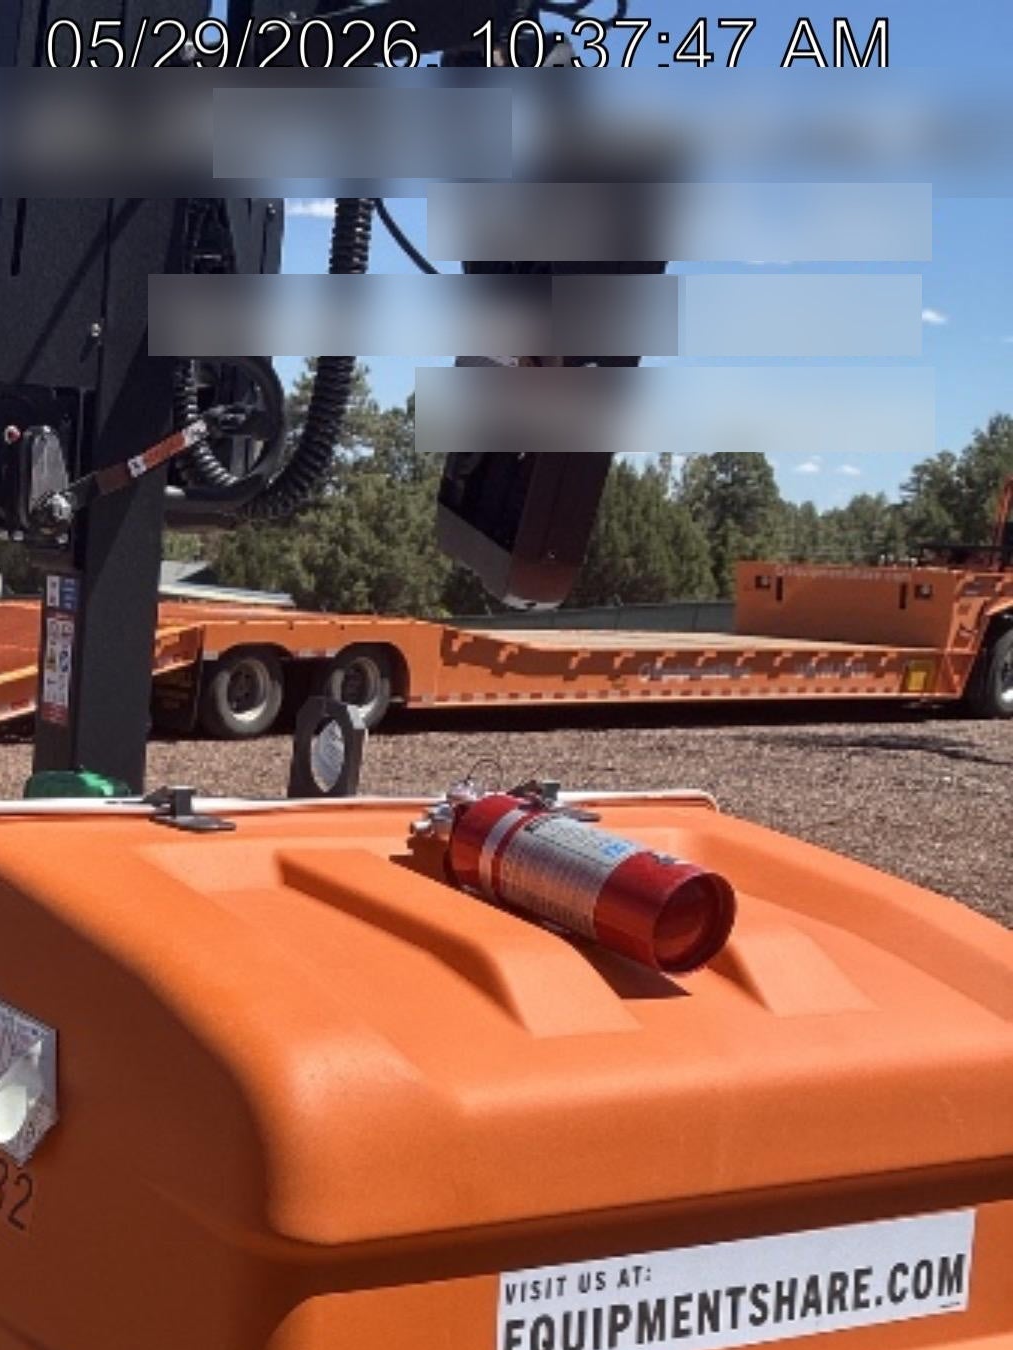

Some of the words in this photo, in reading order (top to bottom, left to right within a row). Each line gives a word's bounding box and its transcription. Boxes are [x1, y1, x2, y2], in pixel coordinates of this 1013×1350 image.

[505, 1275, 566, 1305] VISIT
[578, 1271, 606, 1294] US
[617, 1265, 652, 1288] AT:
